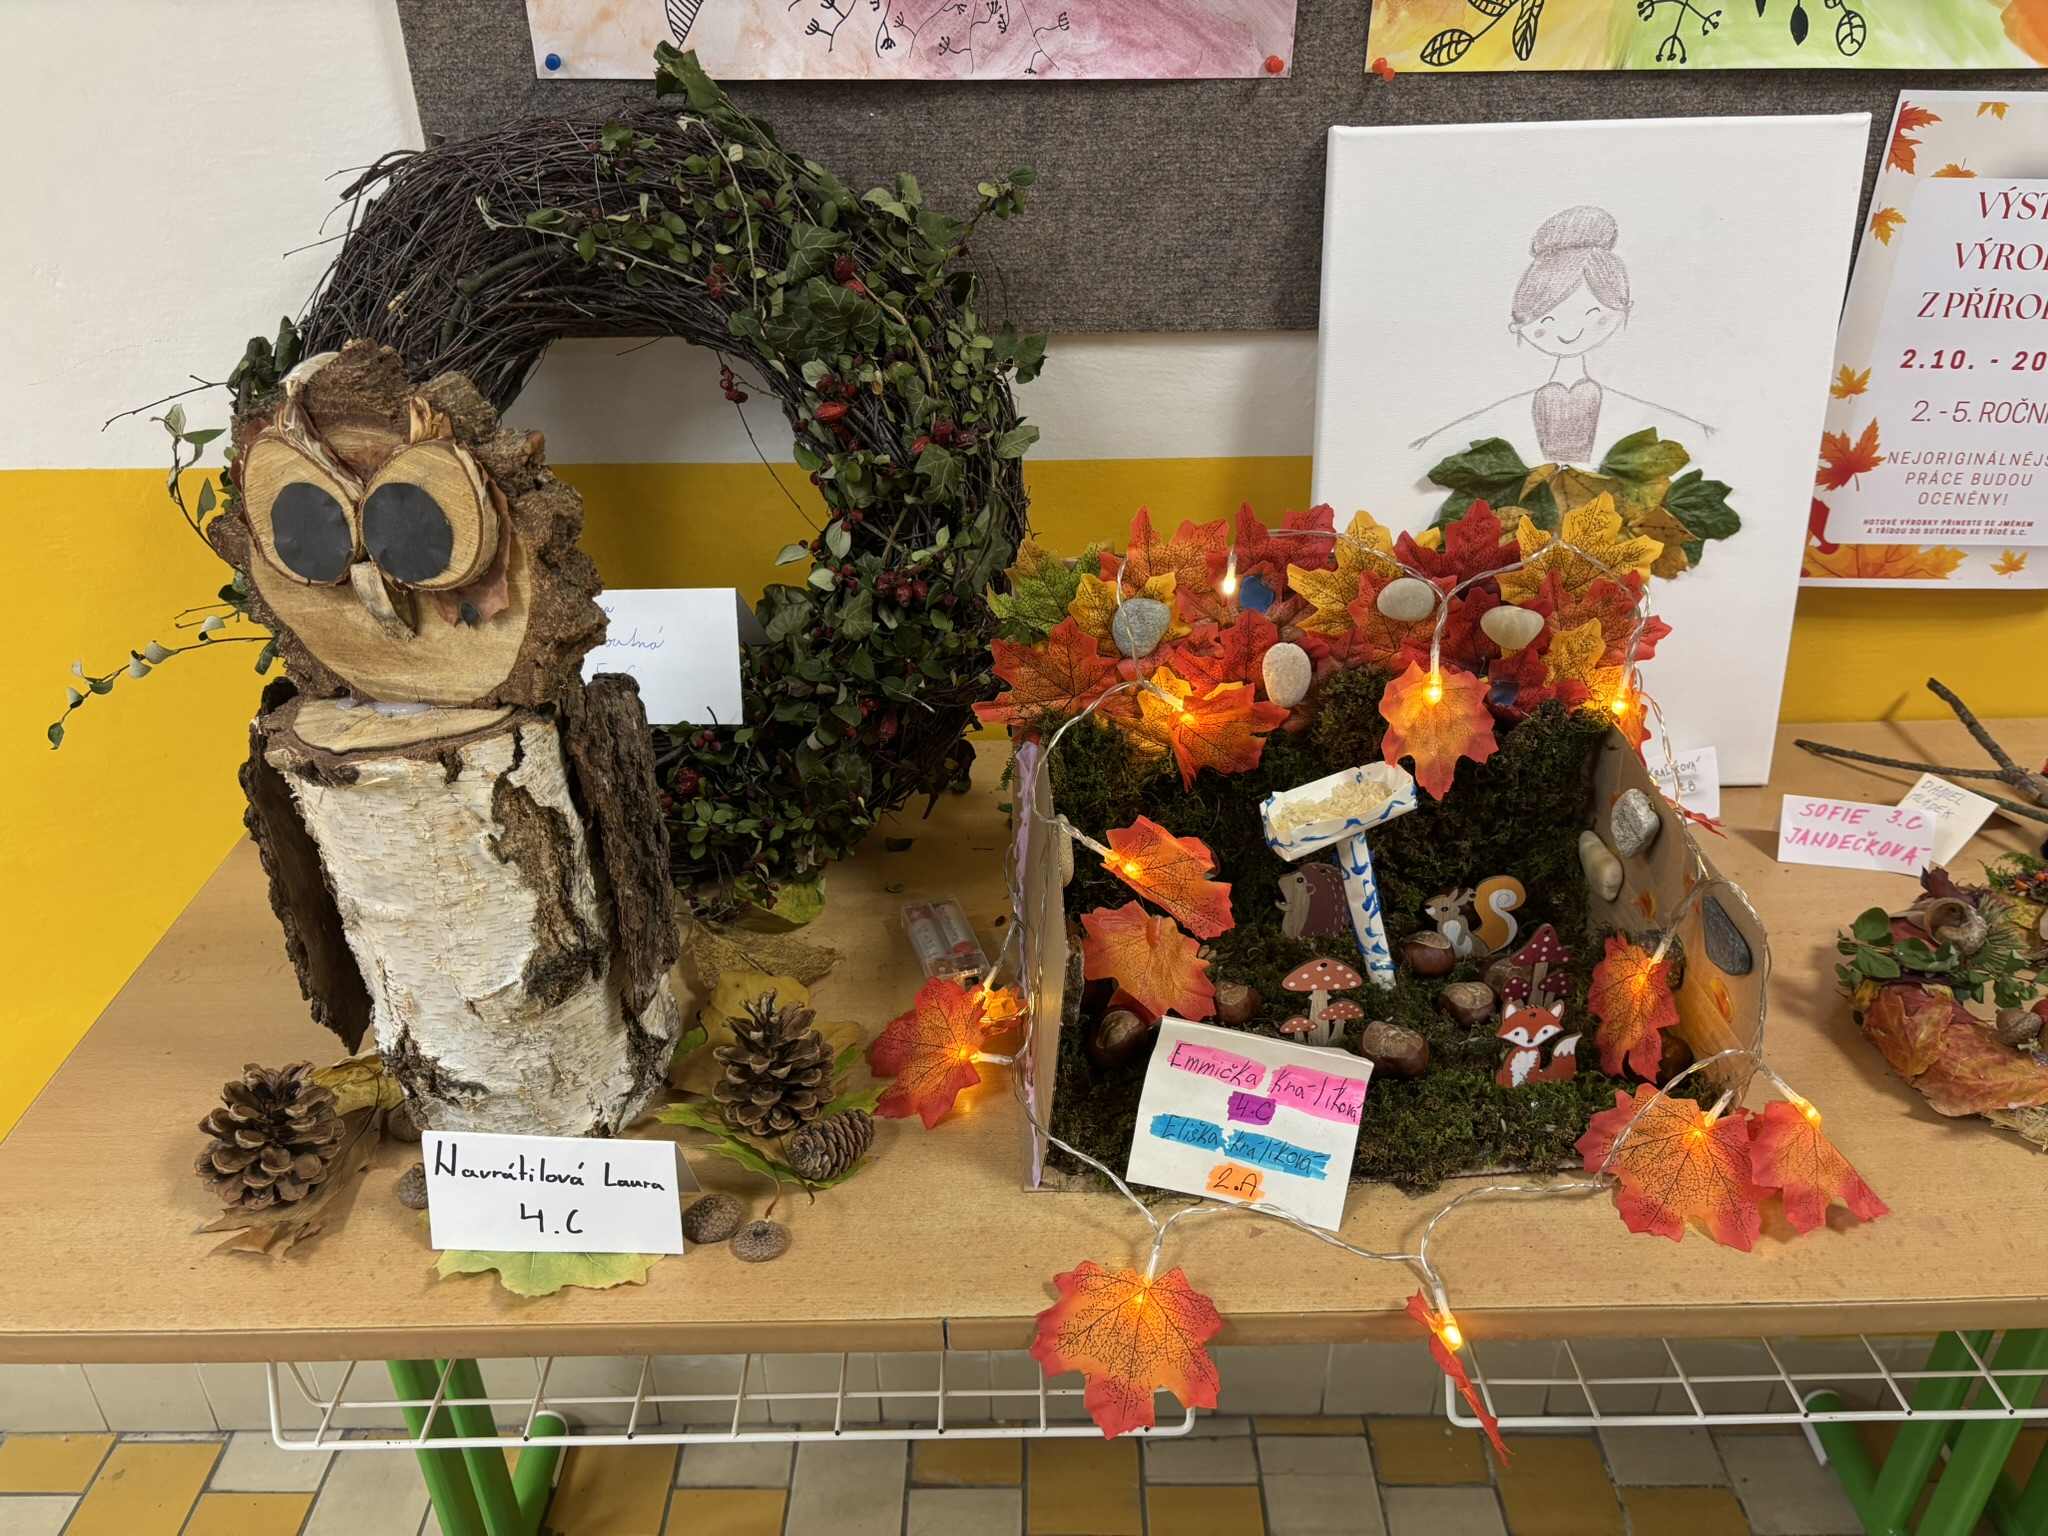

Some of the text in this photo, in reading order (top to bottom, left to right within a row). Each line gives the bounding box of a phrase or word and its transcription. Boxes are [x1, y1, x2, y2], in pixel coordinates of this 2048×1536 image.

[1956, 237, 2048, 271] VÝRO
[1917, 287, 2048, 320] Z PŘÍRO
[1900, 349, 1974, 370] 2.10.
[1978, 398, 2048, 424] ROČN
[1905, 470, 2033, 487] PRÁCE BUDOU
[1918, 490, 2009, 506] OCENĚNY!
[1799, 803, 1923, 830] SOFIE 3.C
[1784, 826, 1932, 866] JANDEČKOVÁ
[1169, 1043, 1258, 1086] Emmička
[1235, 1095, 1273, 1122] 4.C
[1160, 1115, 1219, 1145] Eliška
[434, 1140, 666, 1192] Navrátilová Laura
[1212, 1167, 1258, 1197] 2.A
[519, 1202, 584, 1234] 4.C
